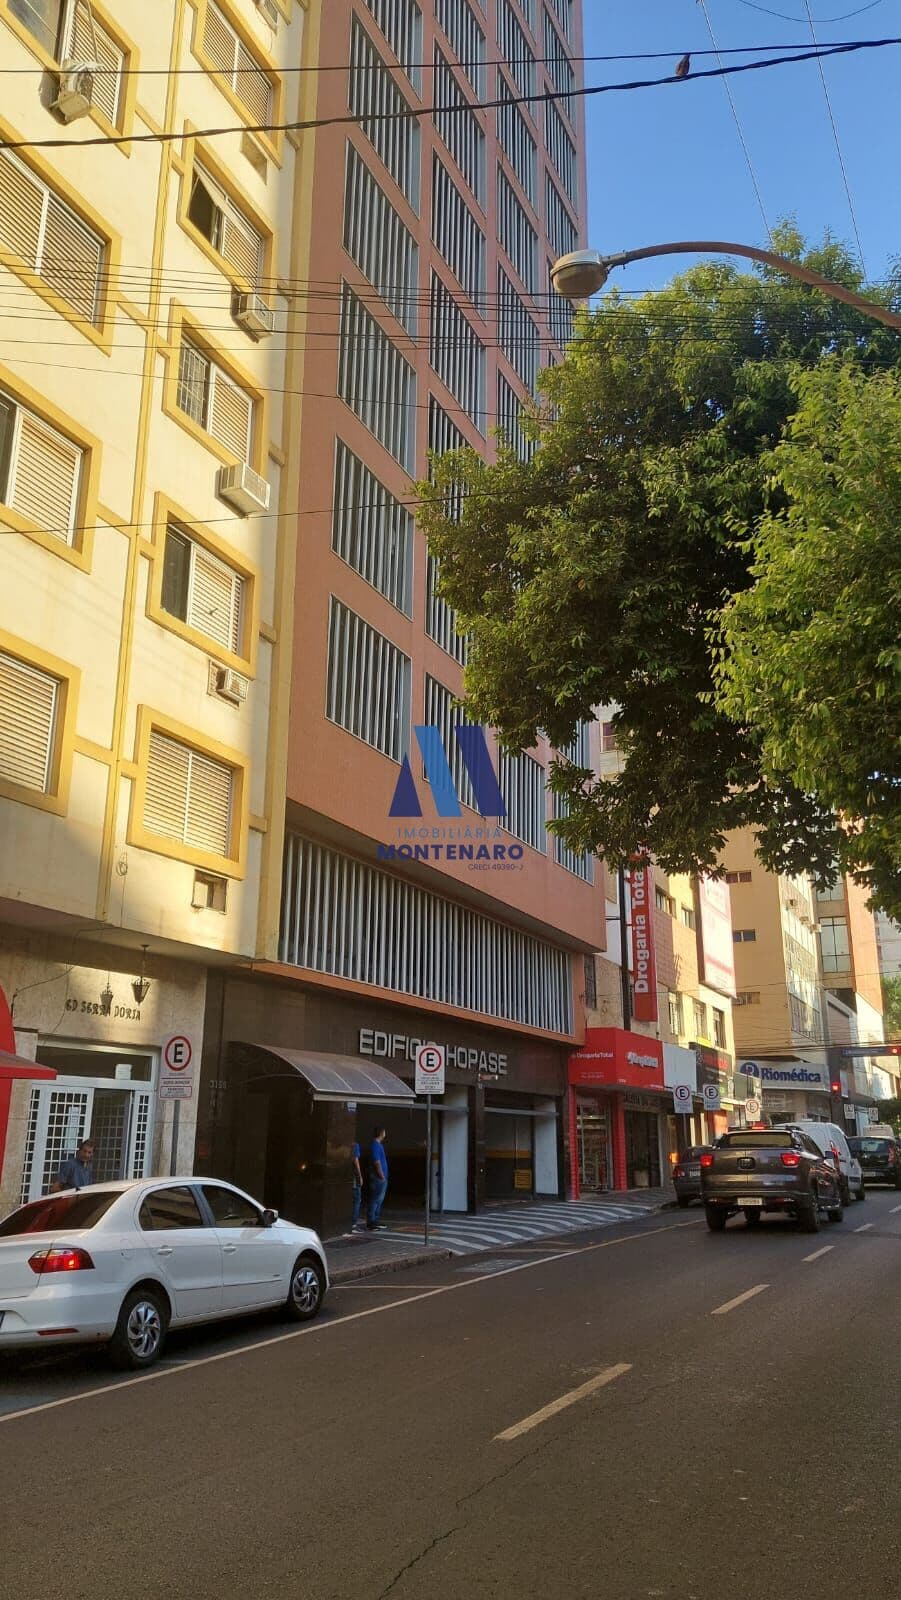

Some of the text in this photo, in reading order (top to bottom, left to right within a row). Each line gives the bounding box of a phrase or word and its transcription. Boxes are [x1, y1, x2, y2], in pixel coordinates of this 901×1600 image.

[632, 870, 649, 993] Drogaria Tota
[174, 1043, 184, 1063] E
[359, 1028, 507, 1075] EDIFIC HOPASE
[426, 1052, 435, 1067] E
[760, 1066, 821, 1083] Riomédica
[679, 1088, 686, 1097] E
[709, 1088, 714, 1096] E
